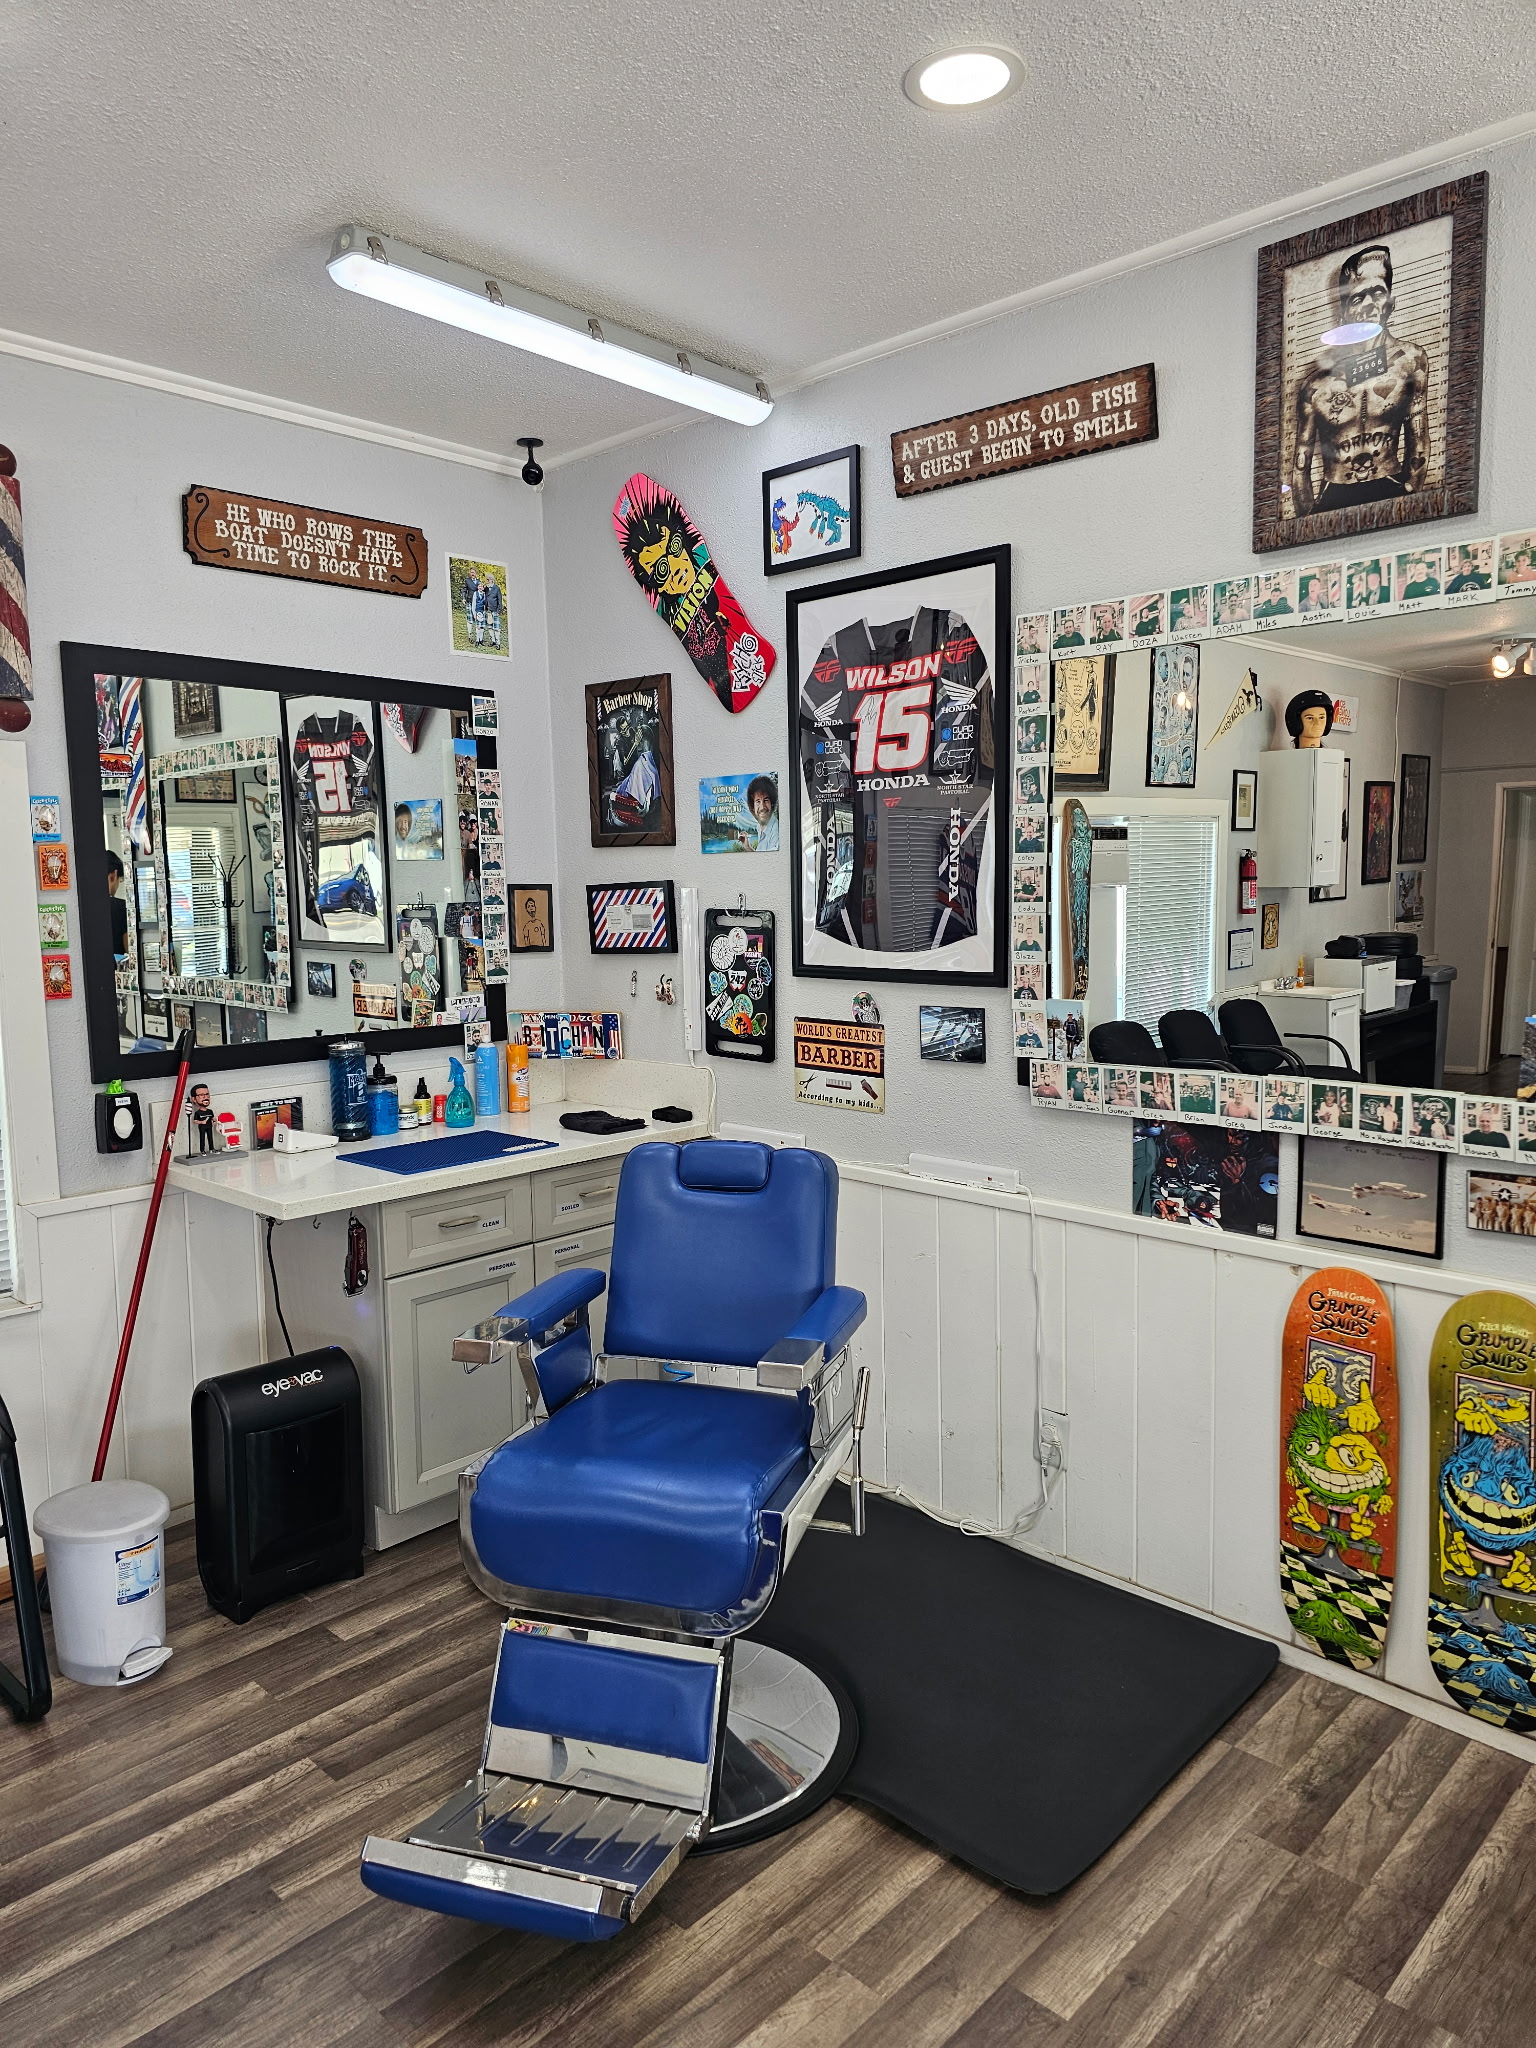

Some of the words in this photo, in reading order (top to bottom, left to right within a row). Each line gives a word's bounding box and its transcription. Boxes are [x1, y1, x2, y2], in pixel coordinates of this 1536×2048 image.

[902, 431, 958, 461] AFTER
[969, 425, 979, 444] 3
[987, 410, 1036, 439] DAYS,
[1041, 398, 1080, 425] OLD
[1092, 381, 1137, 413] FISH
[903, 465, 915, 484] &
[921, 450, 973, 480] GUEST
[982, 435, 1032, 465] BEGIN
[1039, 427, 1065, 450] TO
[1073, 410, 1138, 442] SMELL
[226, 503, 250, 523] HE
[257, 508, 295, 531] WHO
[306, 518, 353, 542] ROWS
[363, 529, 396, 550] THE
[215, 519, 268, 544] BOAT
[281, 532, 350, 558] DOESN'T
[358, 545, 402, 568] HAVE
[232, 541, 279, 565] TIME
[287, 550, 310, 570] TO
[319, 556, 360, 578] ROCK
[368, 564, 388, 583] IT.
[675, 570, 713, 632] VISION
[1448, 593, 1479, 605] MARK
[1256, 619, 1277, 630] Miles
[1347, 609, 1381, 620] Louie
[1172, 632, 1202, 642] Warren
[1216, 625, 1242, 635] ADAM
[1096, 643, 1113, 653] RAY
[1132, 637, 1158, 648] DOZA
[845, 652, 943, 691] WILSON
[603, 694, 632, 714] Barber
[633, 690, 653, 712] Shop
[941, 703, 977, 713] HONDA
[814, 719, 843, 728] HONDA
[853, 683, 933, 774] 15
[953, 732, 974, 740] LOCK
[856, 774, 930, 792] HONDA
[949, 807, 961, 902] HONDA
[730, 975, 745, 985] 242
[796, 1023, 832, 1038] WORLD'S
[836, 1027, 883, 1043] GREATEST
[800, 1044, 878, 1070] BARBER
[798, 1091, 833, 1104] According
[835, 1096, 843, 1104] to
[846, 1099, 856, 1107] my
[1037, 1098, 1057, 1107] RYAN
[482, 1219, 500, 1228] CLEAN
[1308, 1290, 1380, 1326] GRIMPLE
[1318, 1313, 1370, 1337] SNIPS
[1456, 1324, 1536, 1360] GRIMPLE
[1472, 1348, 1528, 1373] SNIPS
